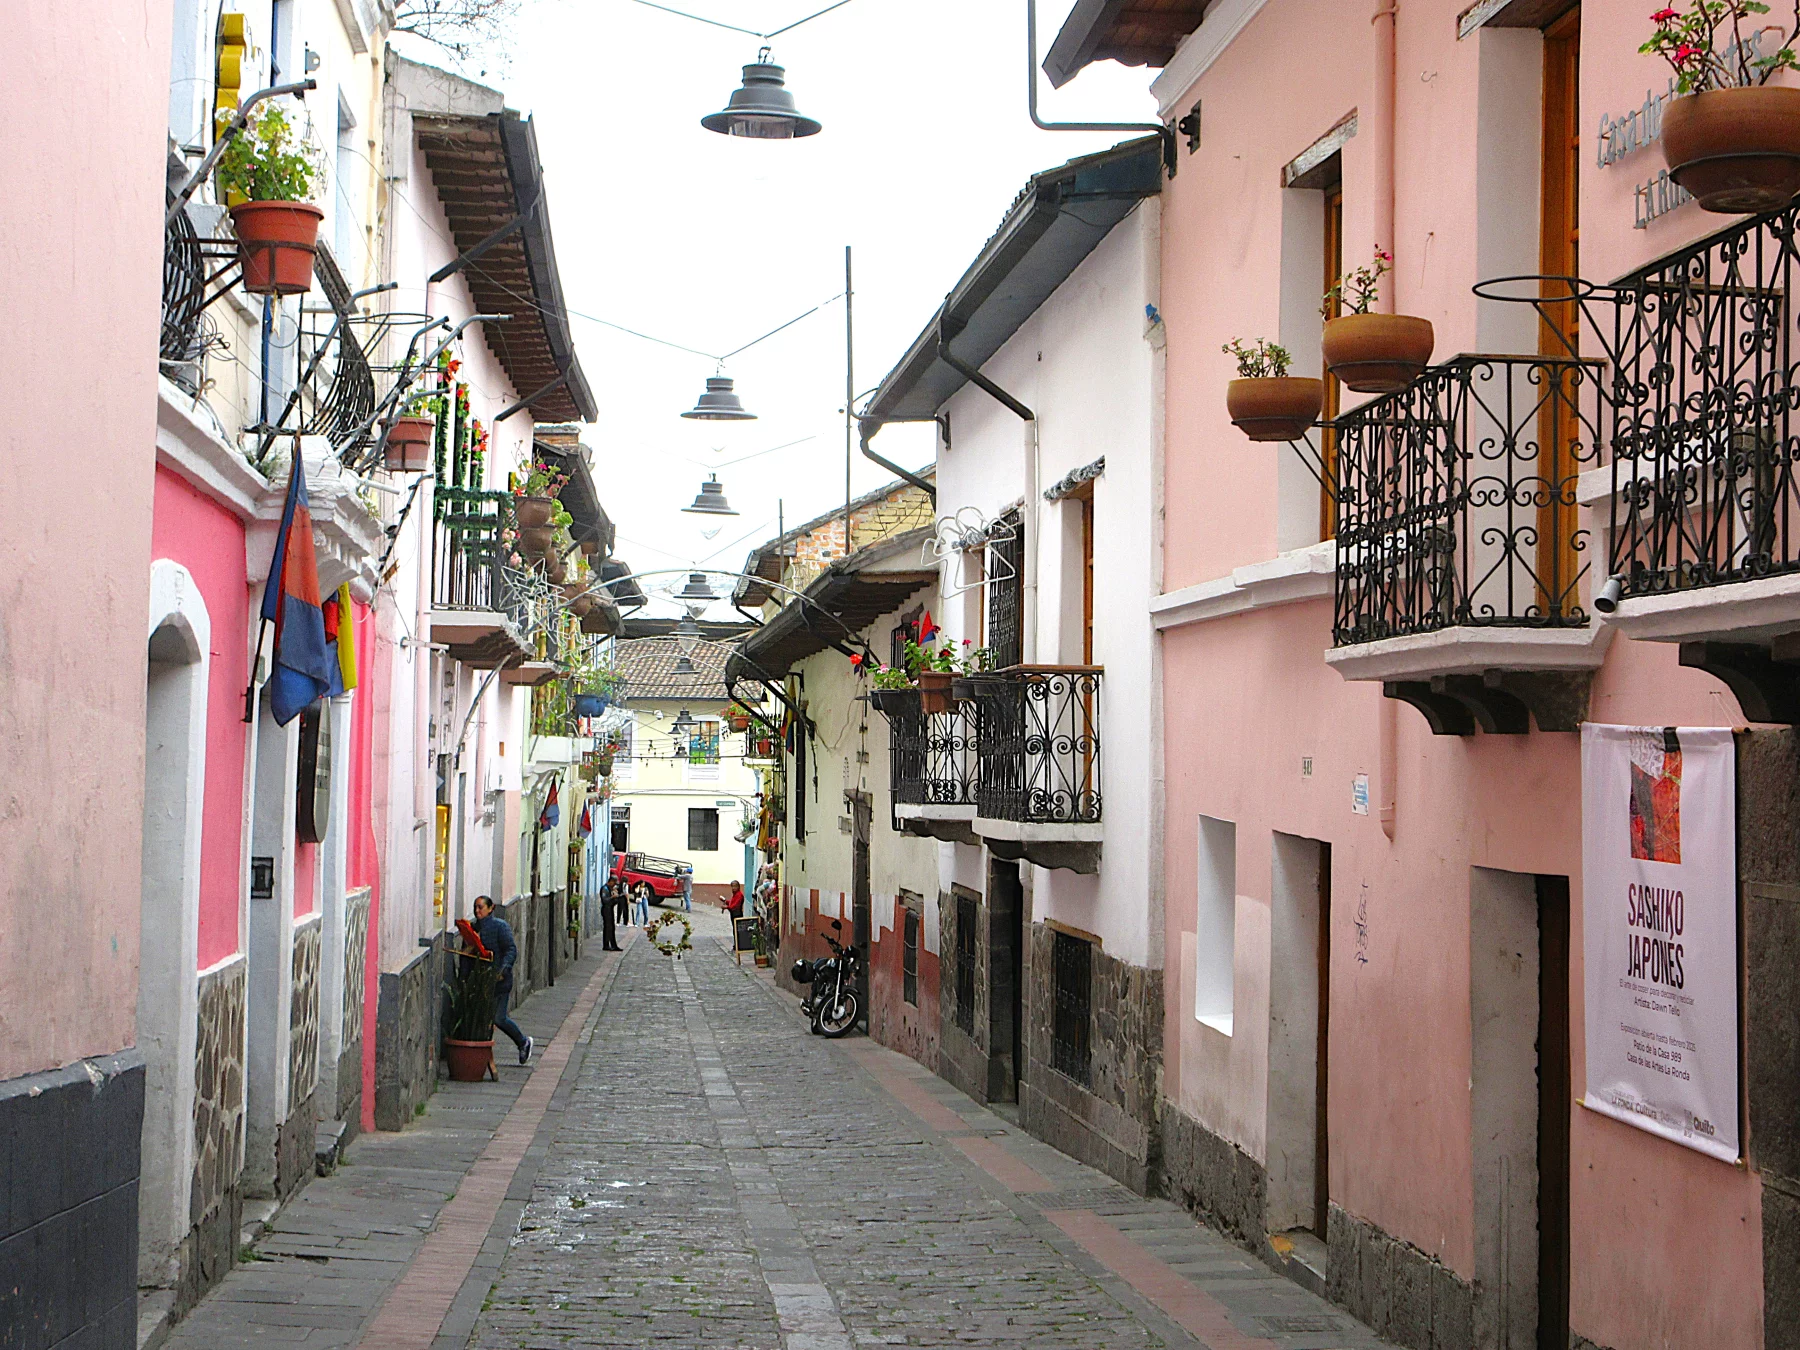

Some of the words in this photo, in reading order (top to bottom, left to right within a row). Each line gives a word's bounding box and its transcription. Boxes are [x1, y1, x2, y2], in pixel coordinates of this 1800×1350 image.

[1597, 110, 1637, 169] Casa
[1641, 89, 1662, 147] de
[1635, 178, 1656, 229] LA
[1627, 883, 1684, 941] SASHIKO
[1633, 1039, 1645, 1052] Patio
[1645, 1043, 1652, 1055] de
[1652, 1045, 1657, 1056] la
[1657, 1047, 1670, 1060] Casa
[1655, 1032, 1669, 1045] hasta
[1626, 1051, 1638, 1064] Casa
[1637, 1055, 1644, 1066] de
[1643, 1057, 1651, 1069] las
[1651, 1060, 1664, 1074] Artes
[1664, 1063, 1671, 1076] La
[1671, 1066, 1690, 1081] Ronda
[1693, 1116, 1715, 1136] Quito
